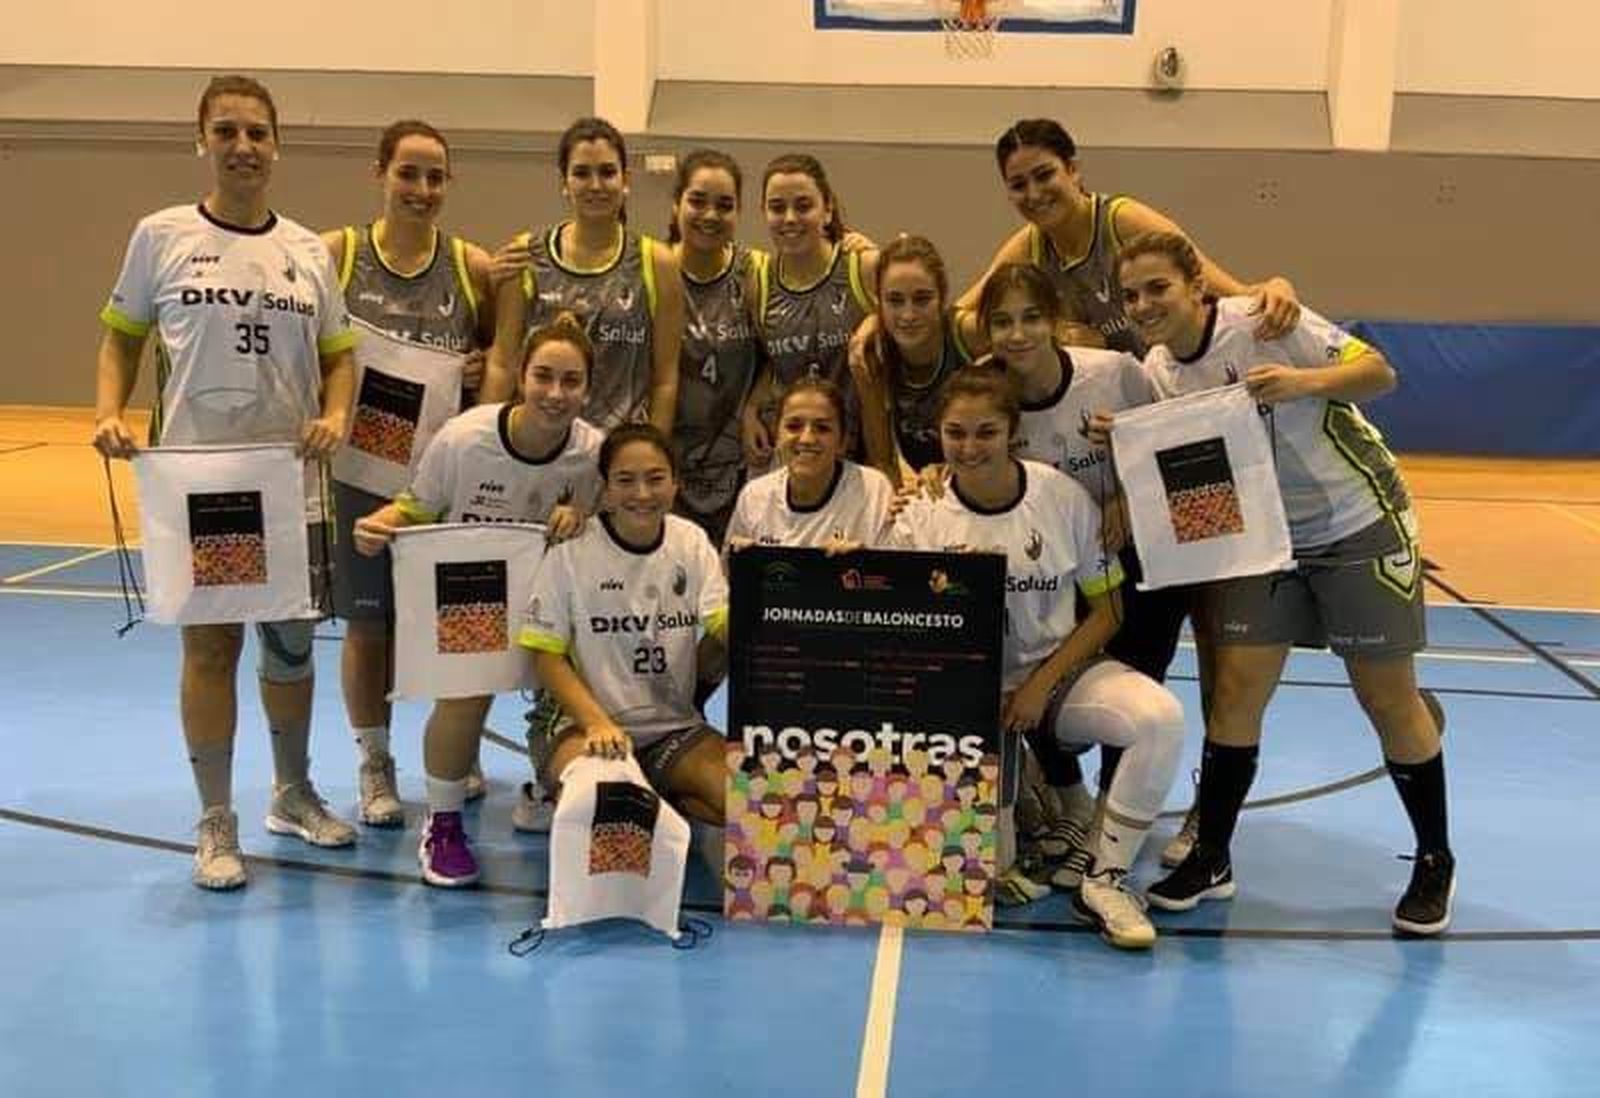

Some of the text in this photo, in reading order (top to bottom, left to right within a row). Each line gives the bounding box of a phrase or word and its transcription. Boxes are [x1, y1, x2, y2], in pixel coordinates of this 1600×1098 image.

[181, 288, 254, 306] DKV
[235, 323, 271, 355] 35
[421, 332, 465, 350] Salu
[600, 323, 646, 343] Salud
[702, 354, 717, 384] 4
[1069, 451, 1106, 473] Salu
[1006, 575, 1058, 593] Salud
[590, 615, 650, 633] DKV
[634, 646, 668, 674] 23
[743, 722, 985, 769] nosotras
